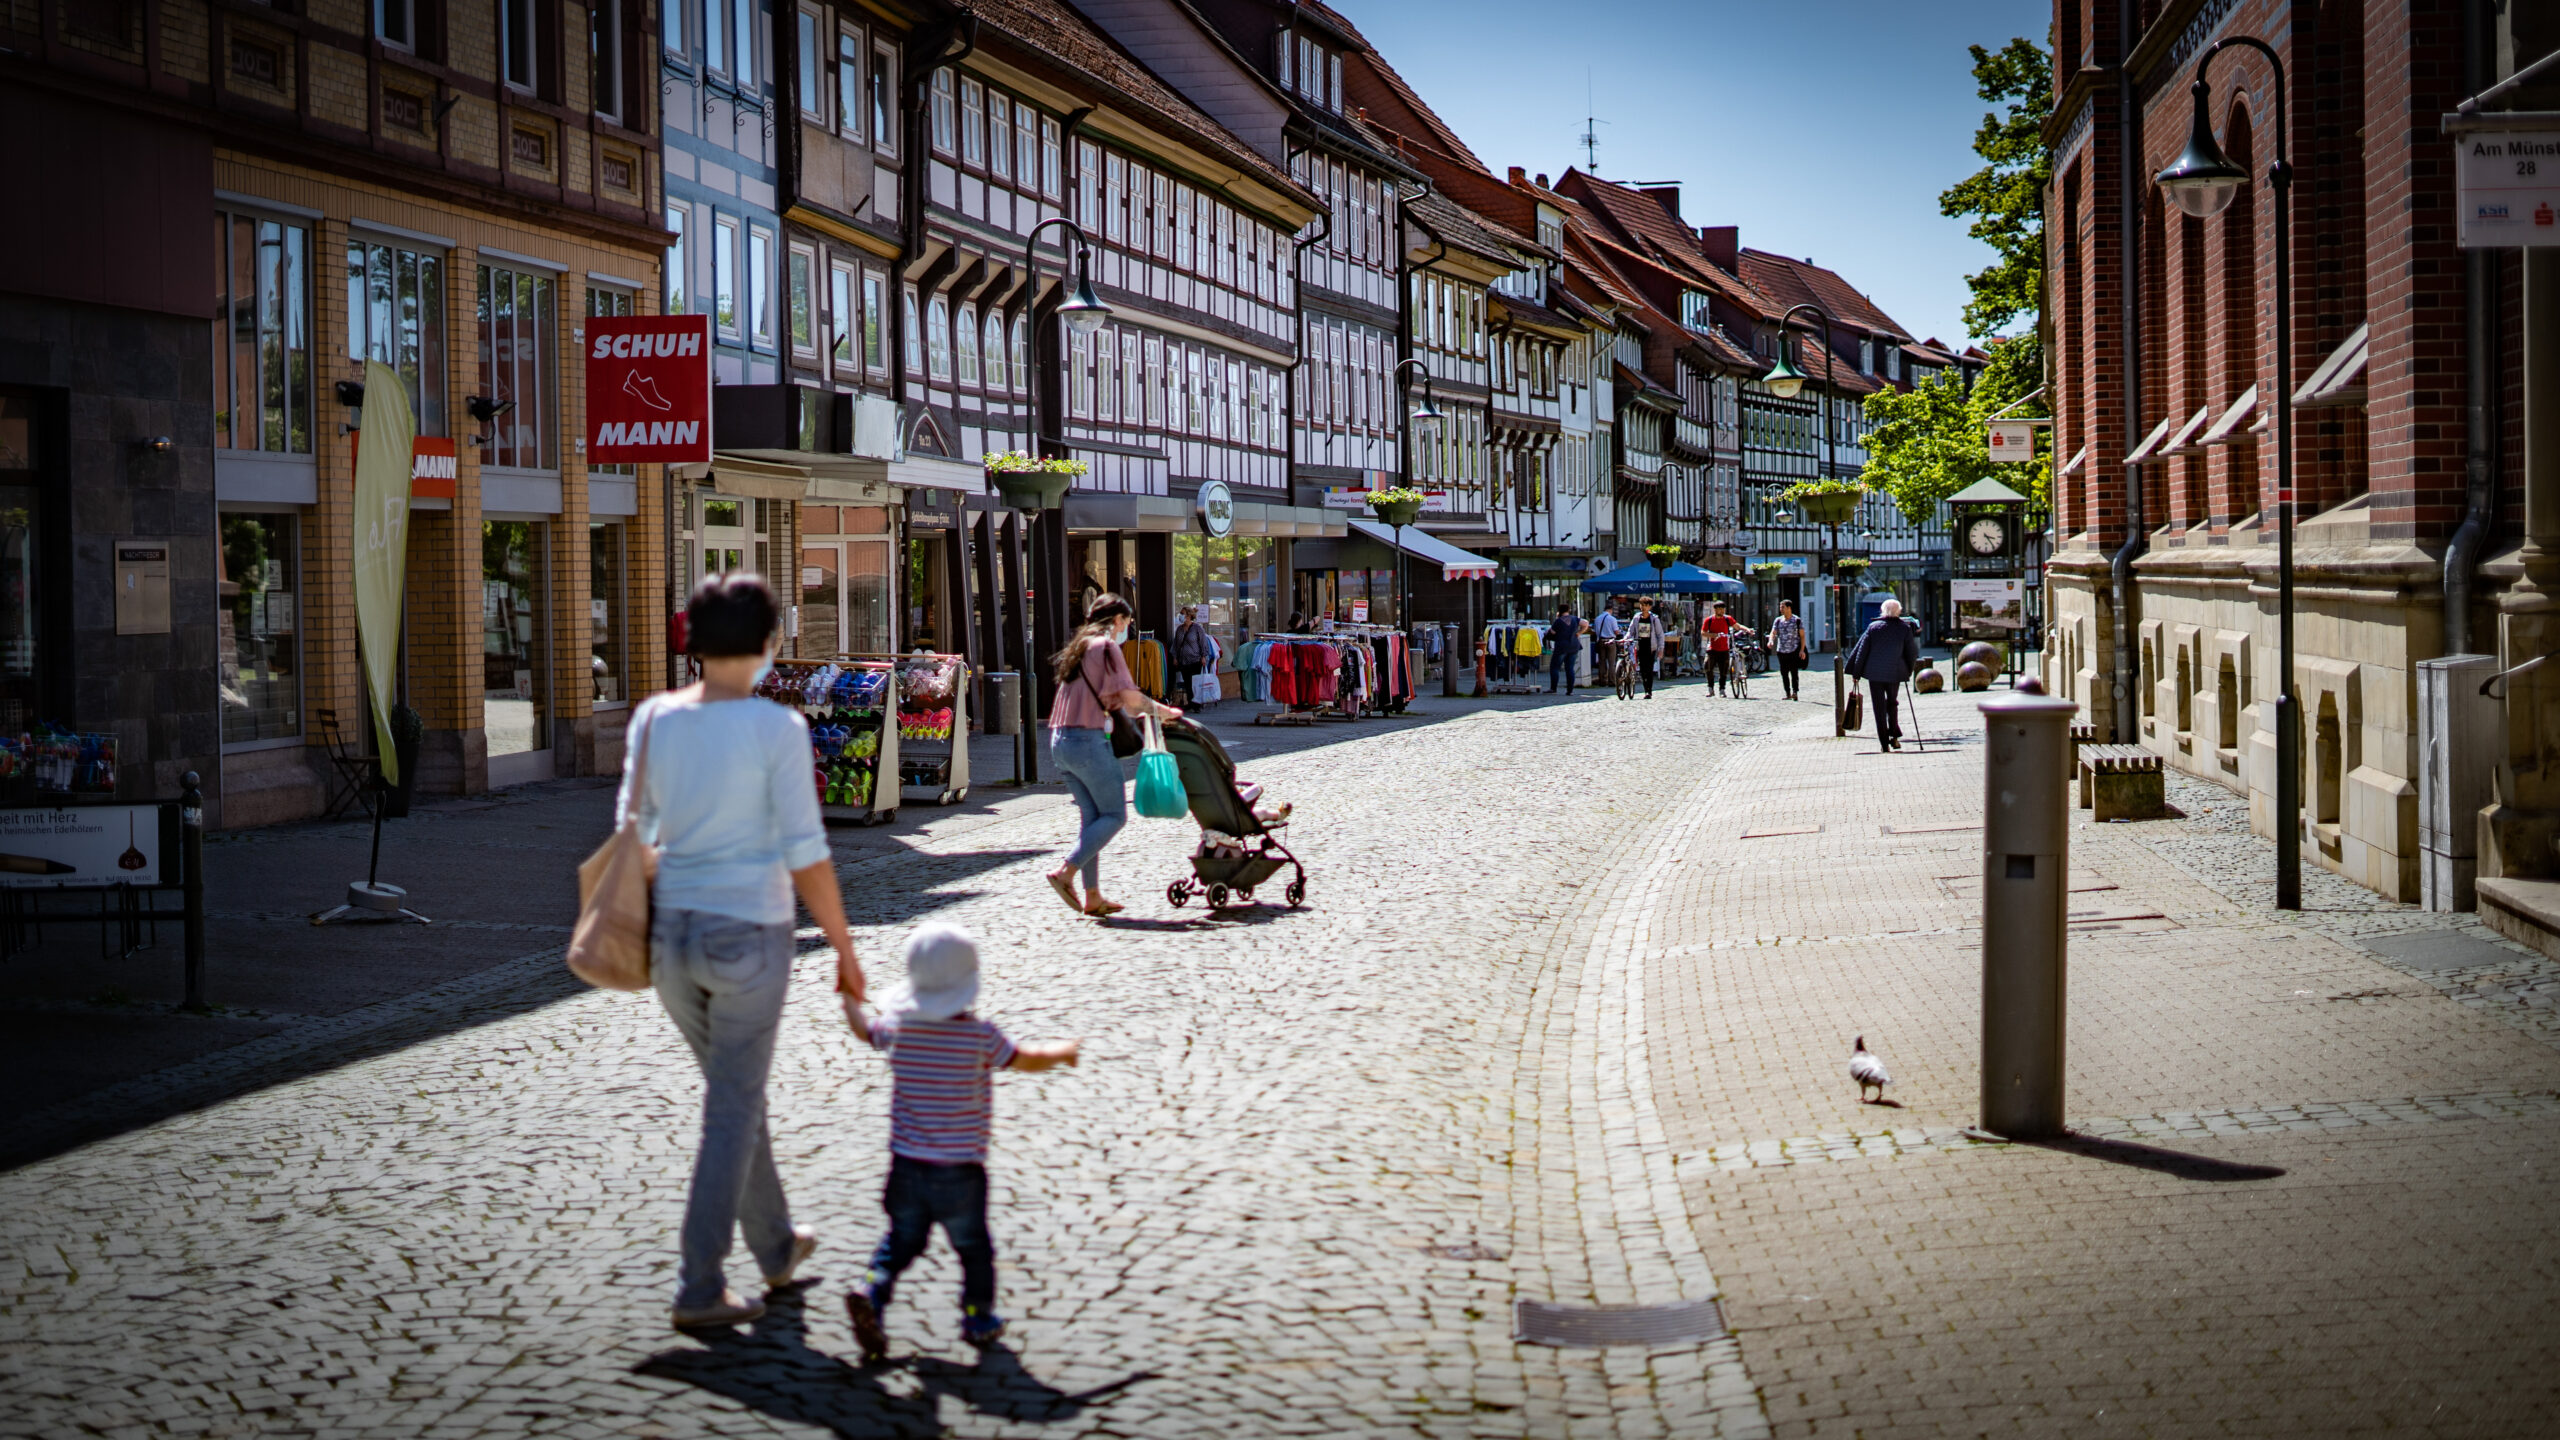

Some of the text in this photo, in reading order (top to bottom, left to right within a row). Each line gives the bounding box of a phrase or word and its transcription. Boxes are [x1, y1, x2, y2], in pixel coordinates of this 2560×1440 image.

[2473, 142, 2502, 156] Am
[2516, 161, 2536, 175] 28
[592, 333, 701, 359] SCHUH
[596, 421, 699, 447] MANN
[415, 454, 457, 479] MANN
[24, 813, 44, 824] mit
[49, 811, 77, 823] Herz
[5, 825, 103, 835] heimischen Edelhölzern
